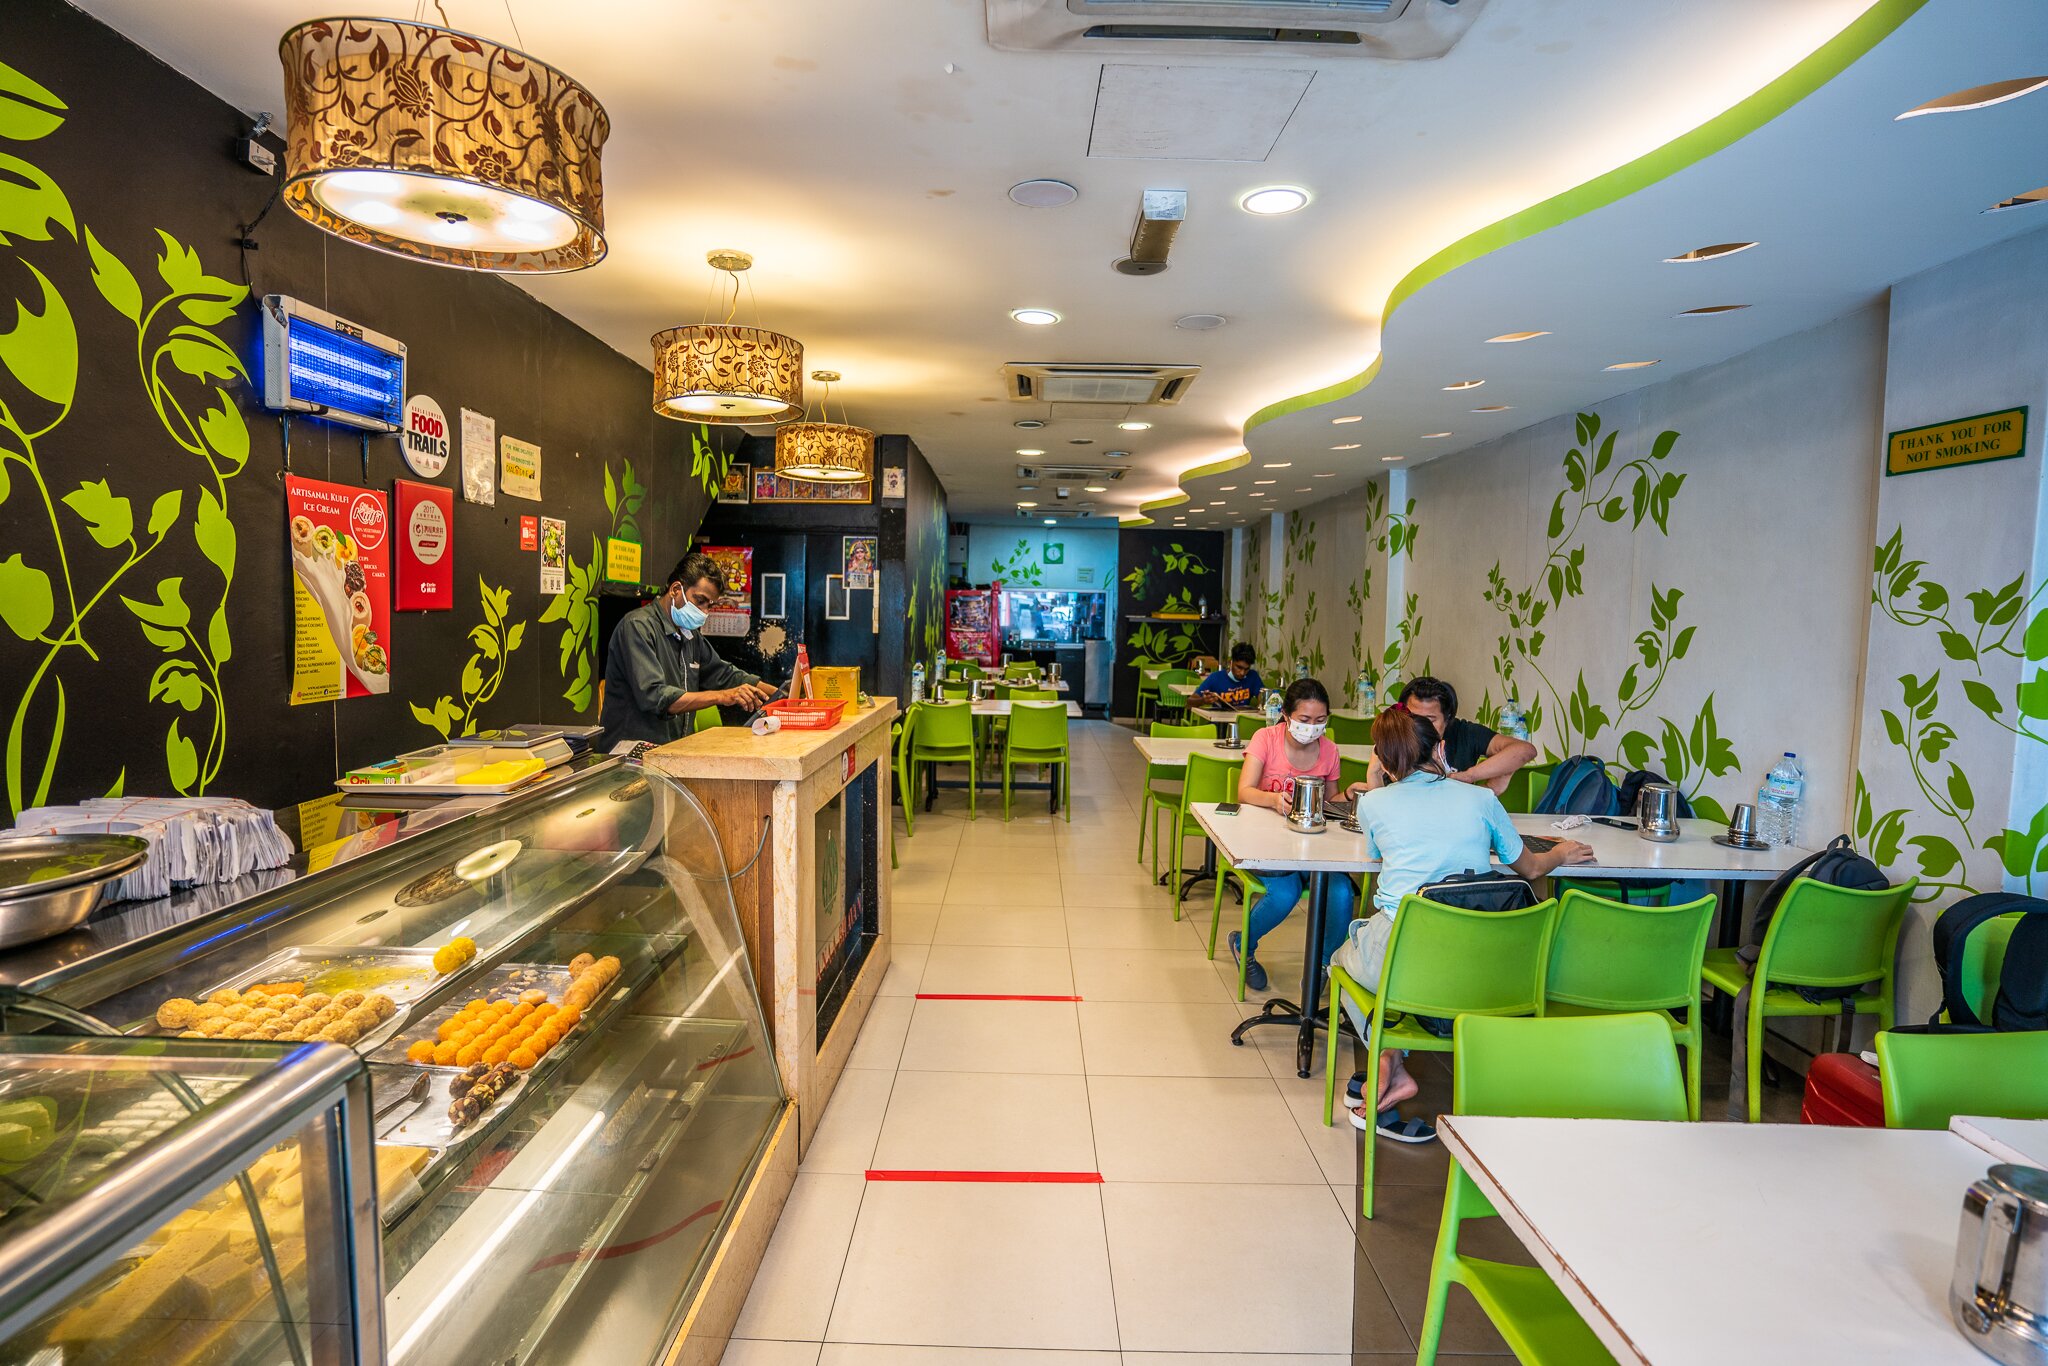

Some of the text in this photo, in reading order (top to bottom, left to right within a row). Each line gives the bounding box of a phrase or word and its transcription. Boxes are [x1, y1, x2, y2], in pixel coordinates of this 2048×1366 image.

[412, 412, 443, 438] FOOD
[1898, 420, 2012, 451] THANK YOU FOR
[406, 430, 447, 458] TRAILS
[1906, 438, 2001, 465] NOT SMOKING
[291, 487, 349, 503] ARTISANAL KULFI
[304, 502, 340, 515] ICE CREAM
[423, 505, 434, 513] 2017
